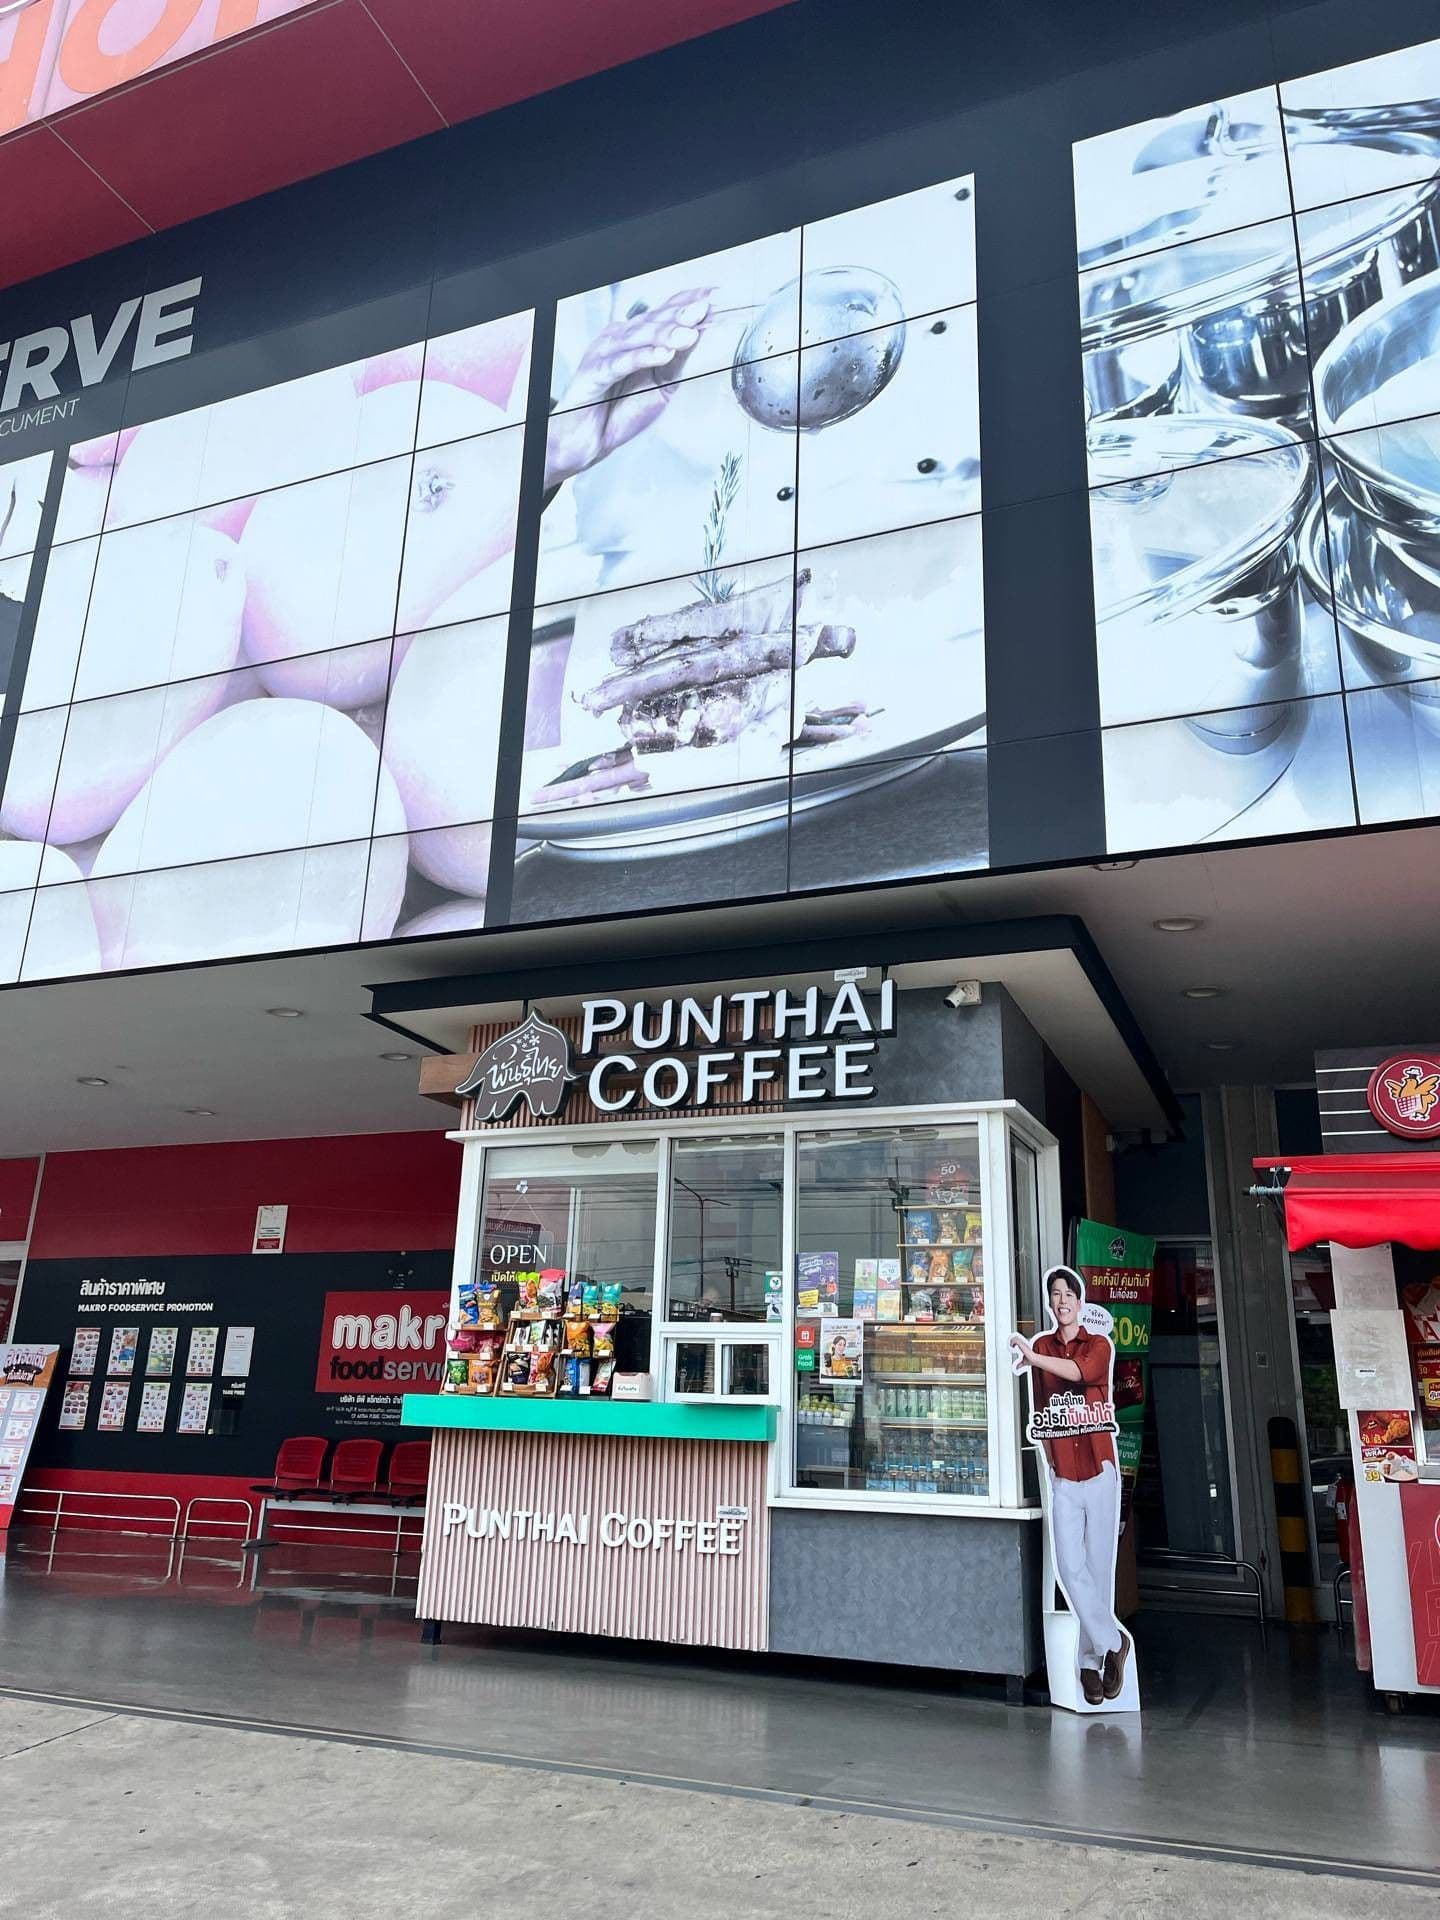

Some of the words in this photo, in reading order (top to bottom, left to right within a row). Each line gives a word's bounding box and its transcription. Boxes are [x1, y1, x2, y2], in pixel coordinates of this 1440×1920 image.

[0, 276, 202, 413] RVE
[581, 979, 894, 1054] PUNTHAI
[588, 1042, 875, 1112] COFFEE
[490, 1244, 547, 1265] OPEN
[80, 1279, 165, 1296] สินค้าราคาพิเศษ
[491, 1270, 520, 1282] เปิดให้
[78, 1304, 107, 1312] MAKRO
[108, 1303, 165, 1312] FOODSERVICE
[166, 1303, 213, 1312] PROMOTION
[332, 1304, 449, 1350] makr
[1365, 1448, 1387, 1457] WRAP
[444, 1503, 588, 1545] PUNTHAI
[600, 1512, 744, 1555] COFFEE
